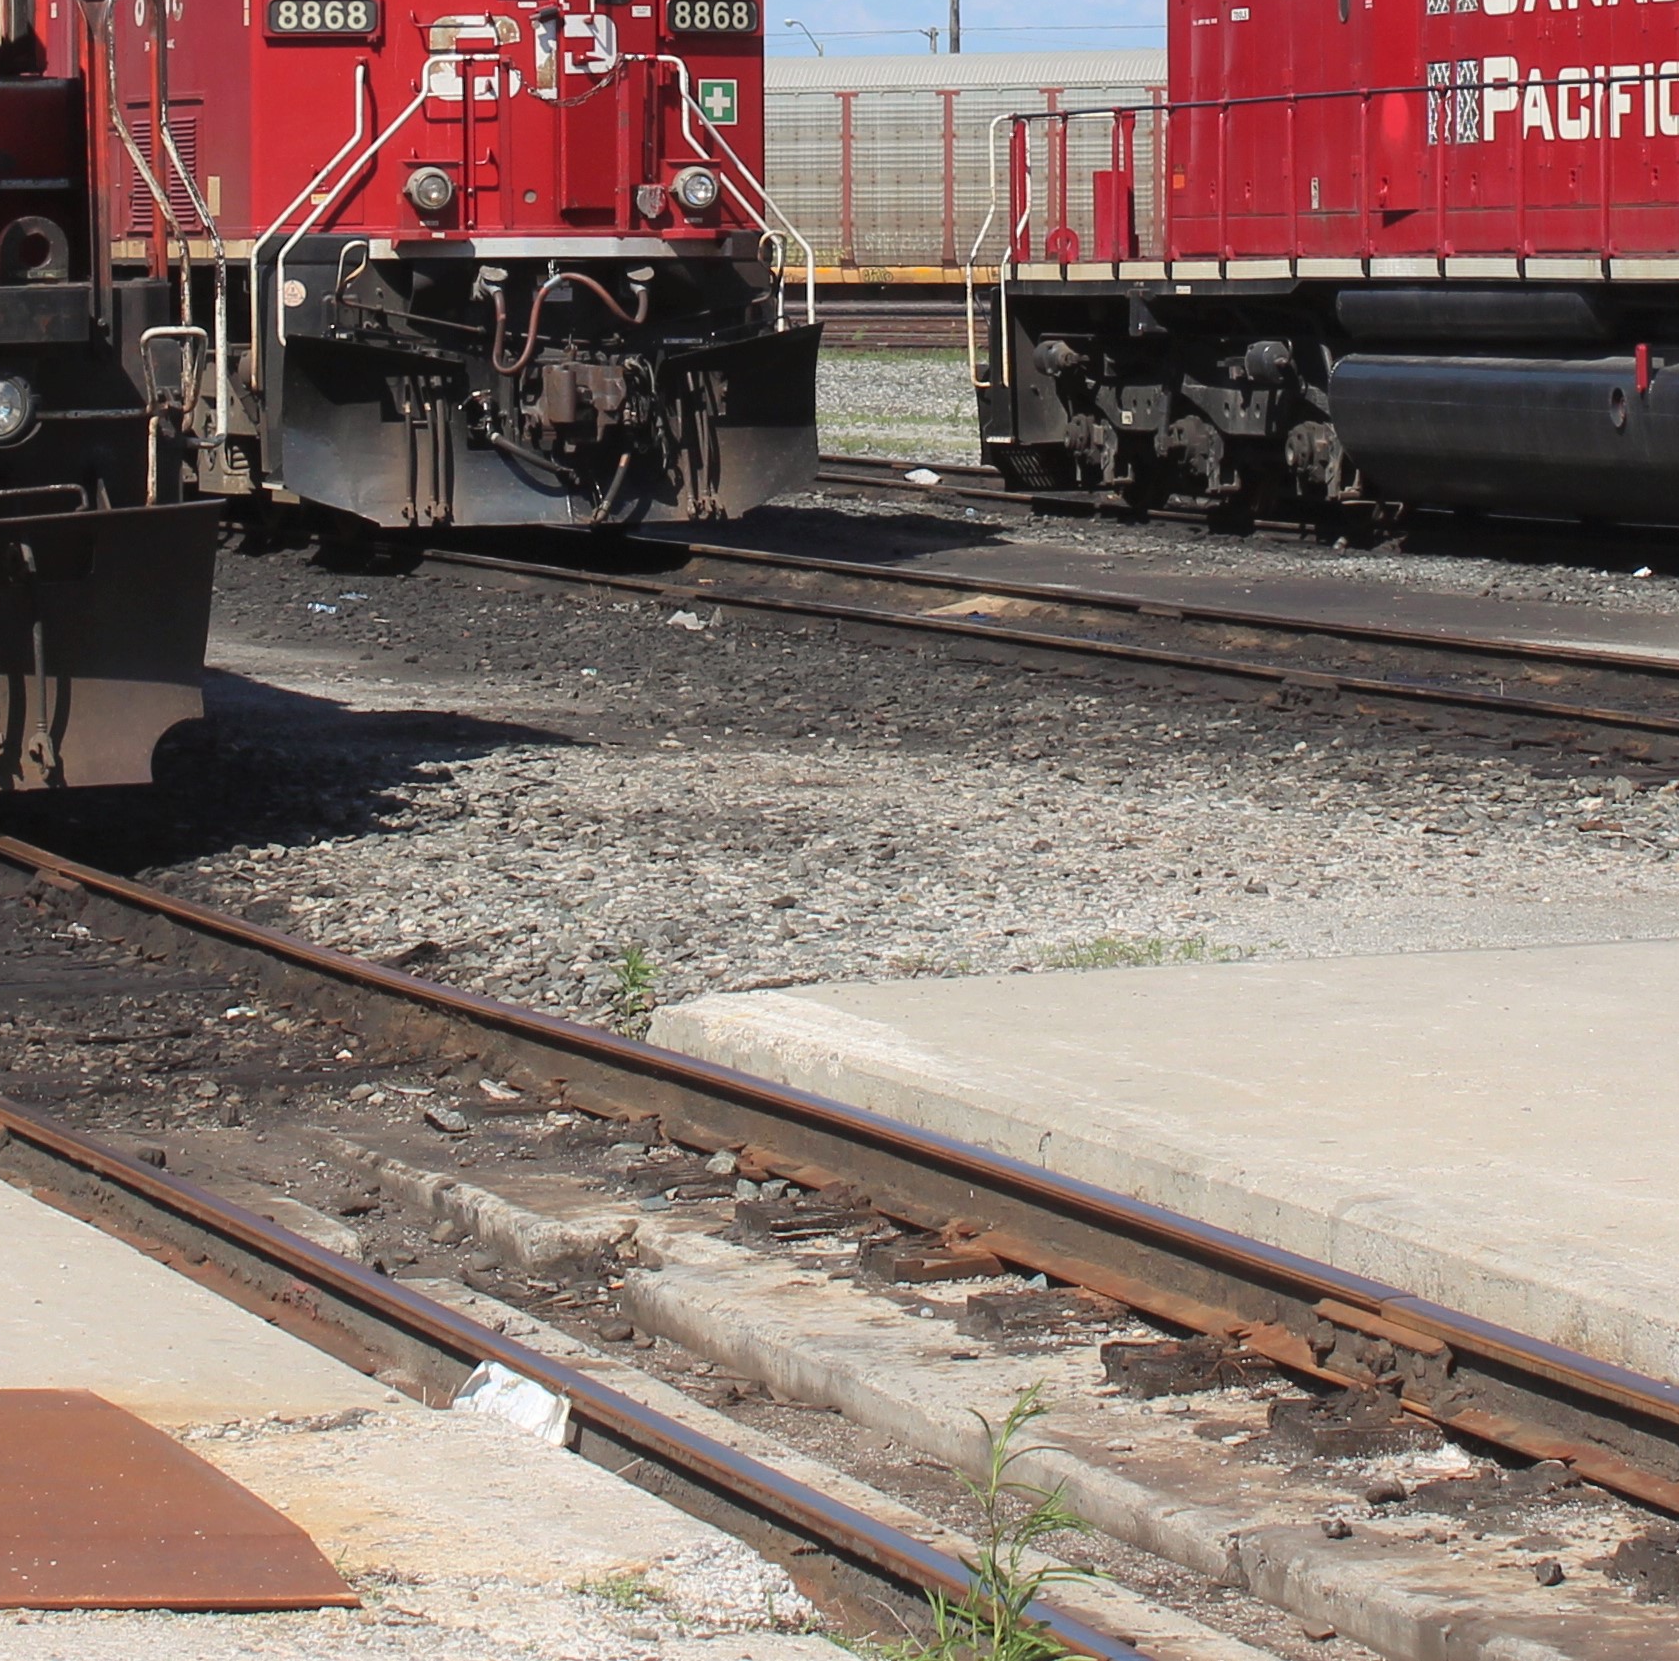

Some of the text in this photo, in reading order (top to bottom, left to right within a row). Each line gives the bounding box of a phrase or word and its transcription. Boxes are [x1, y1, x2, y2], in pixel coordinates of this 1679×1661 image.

[278, 1, 367, 29] 8868
[675, 1, 748, 29] 8868
[429, 13, 617, 100] CP
